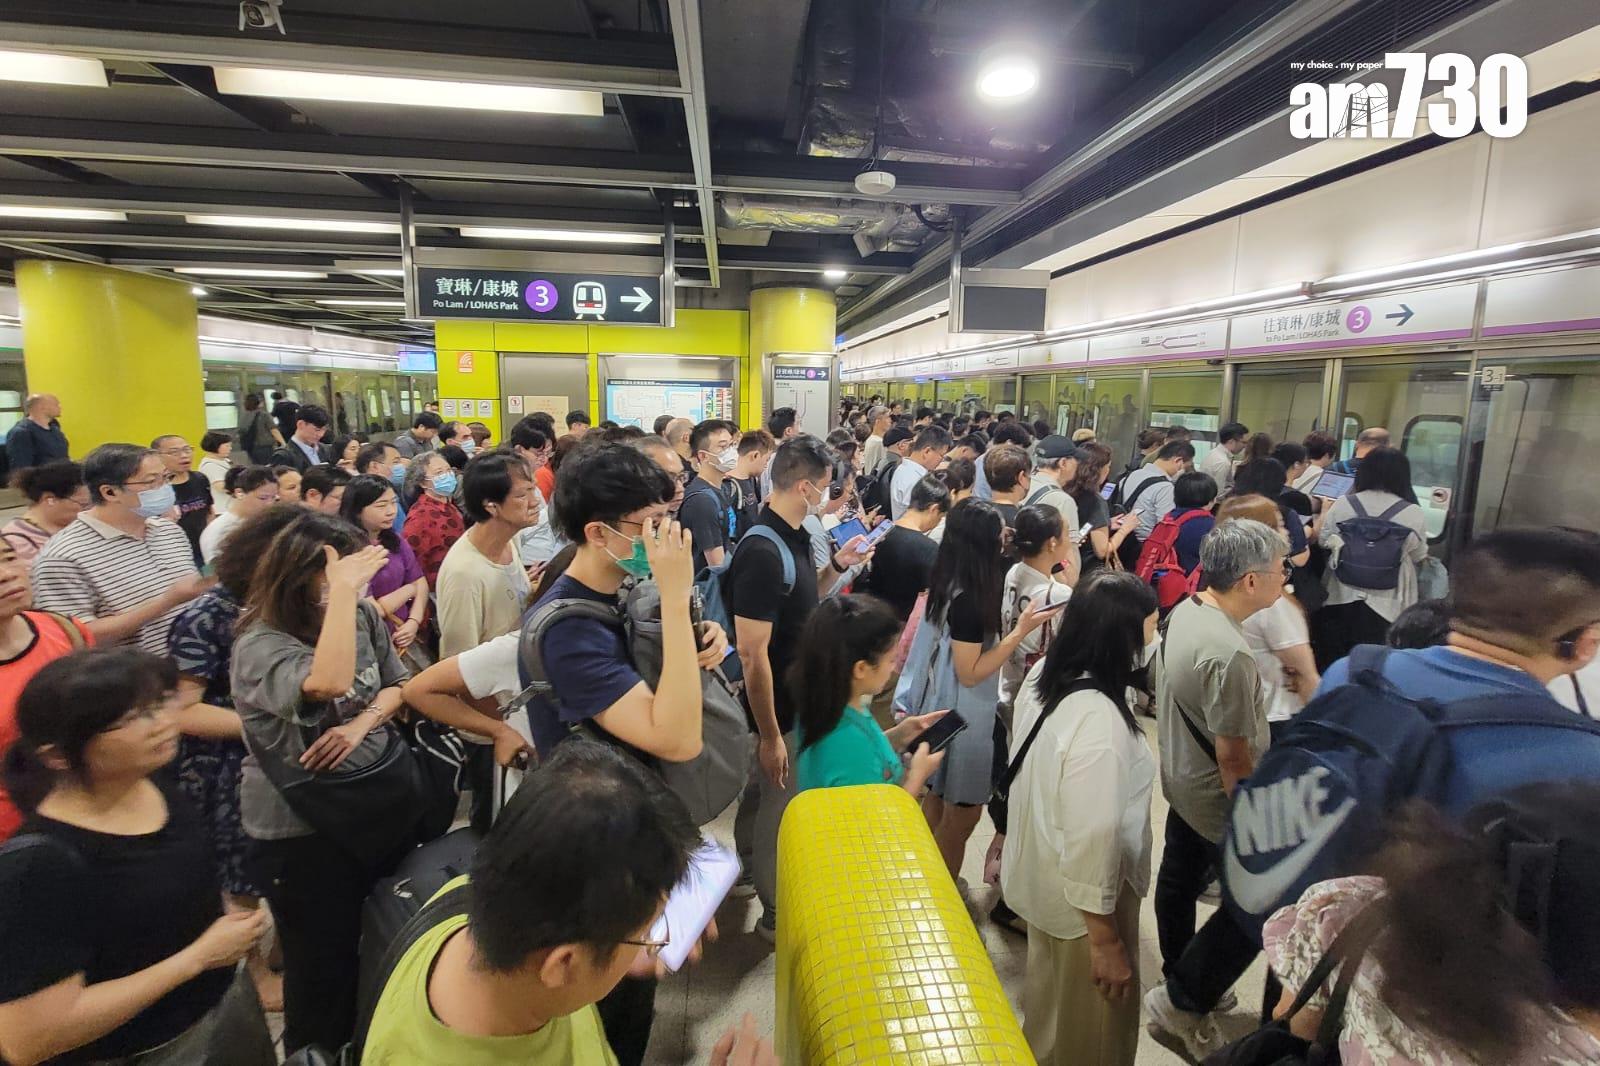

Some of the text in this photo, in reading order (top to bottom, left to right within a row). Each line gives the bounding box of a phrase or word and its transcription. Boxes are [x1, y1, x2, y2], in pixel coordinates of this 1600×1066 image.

[433, 299, 444, 308] Po
[445, 300, 463, 309] Lam
[470, 301, 498, 310] LOHAS
[500, 301, 519, 311] Park
[535, 285, 549, 307] 3
[1352, 310, 1365, 329] 3
[1232, 766, 1331, 856] NIKE
